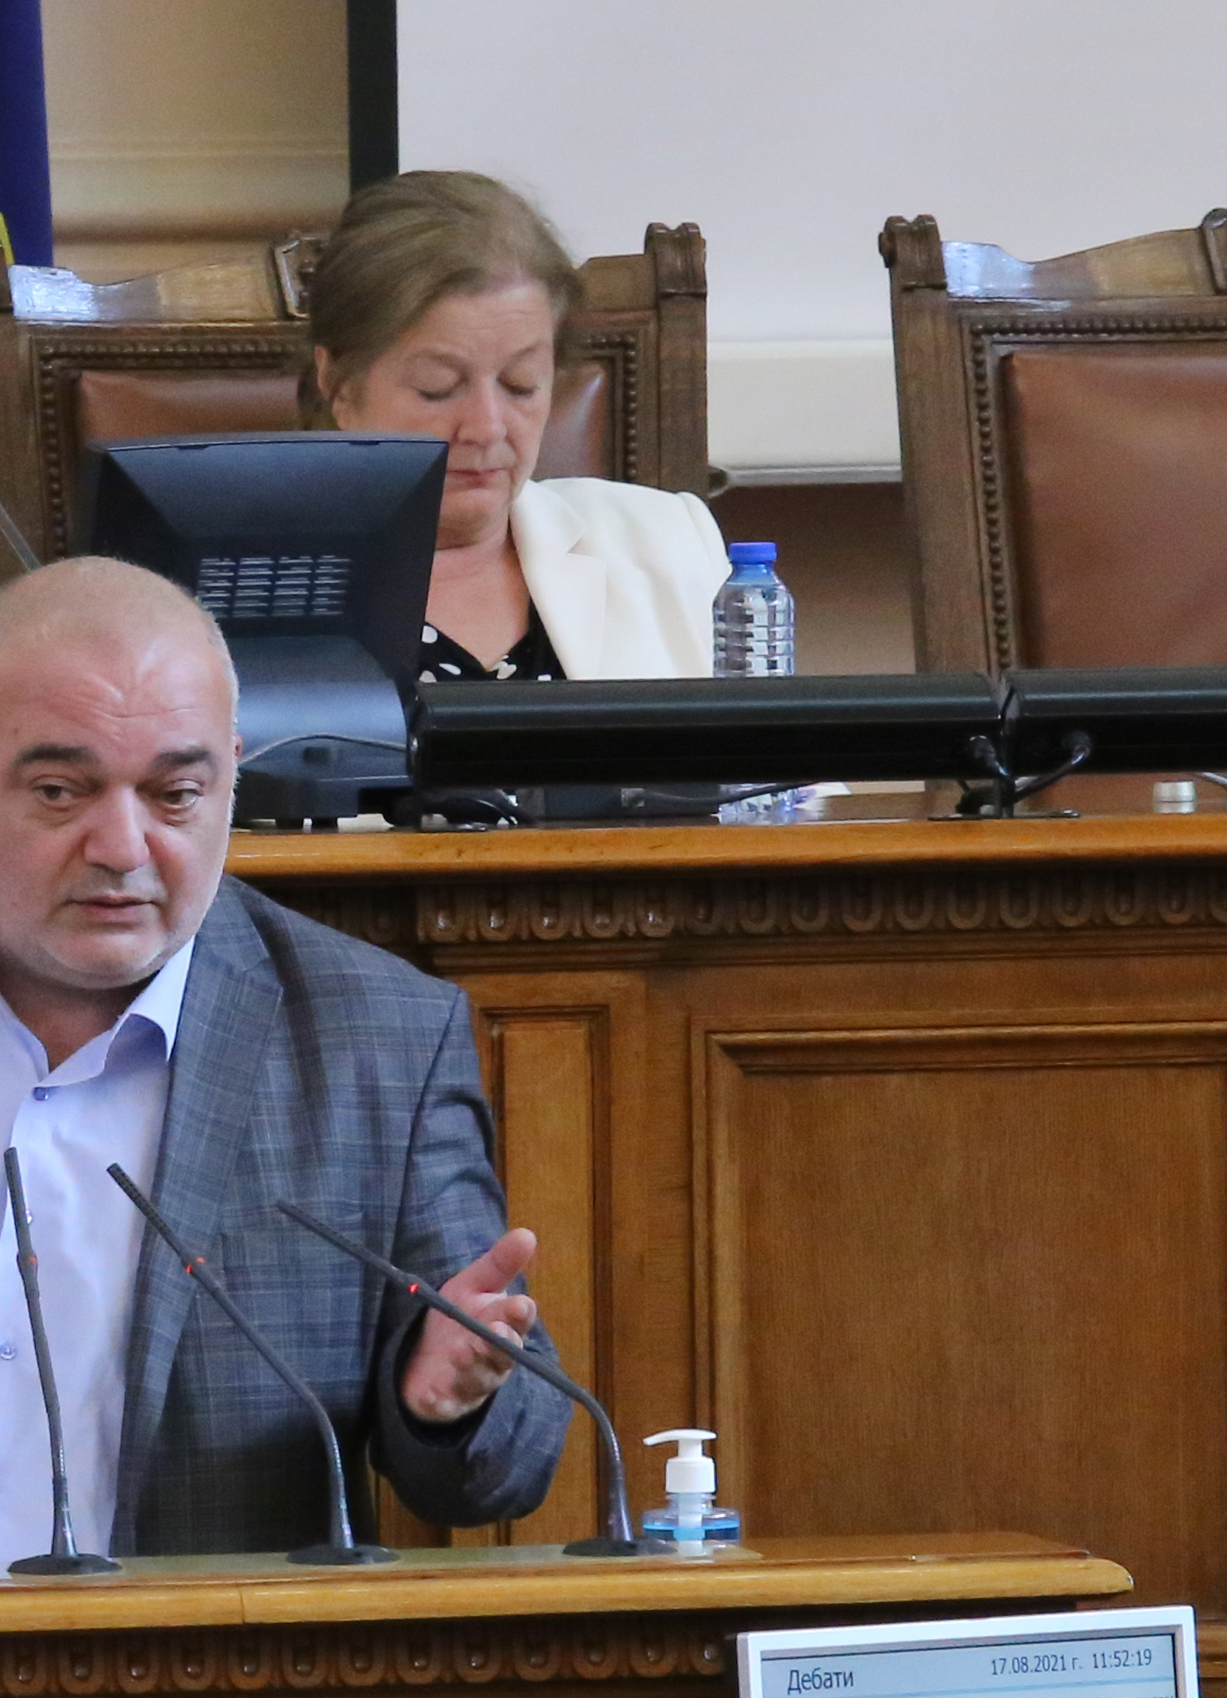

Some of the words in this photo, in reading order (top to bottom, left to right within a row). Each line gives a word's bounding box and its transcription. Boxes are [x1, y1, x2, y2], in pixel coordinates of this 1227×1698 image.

[991, 1654, 1067, 1675] 17.08.2021
[1071, 1656, 1083, 1670] г.
[1092, 1648, 1152, 1669] 11:52:19
[787, 1667, 854, 1695] Дебати
